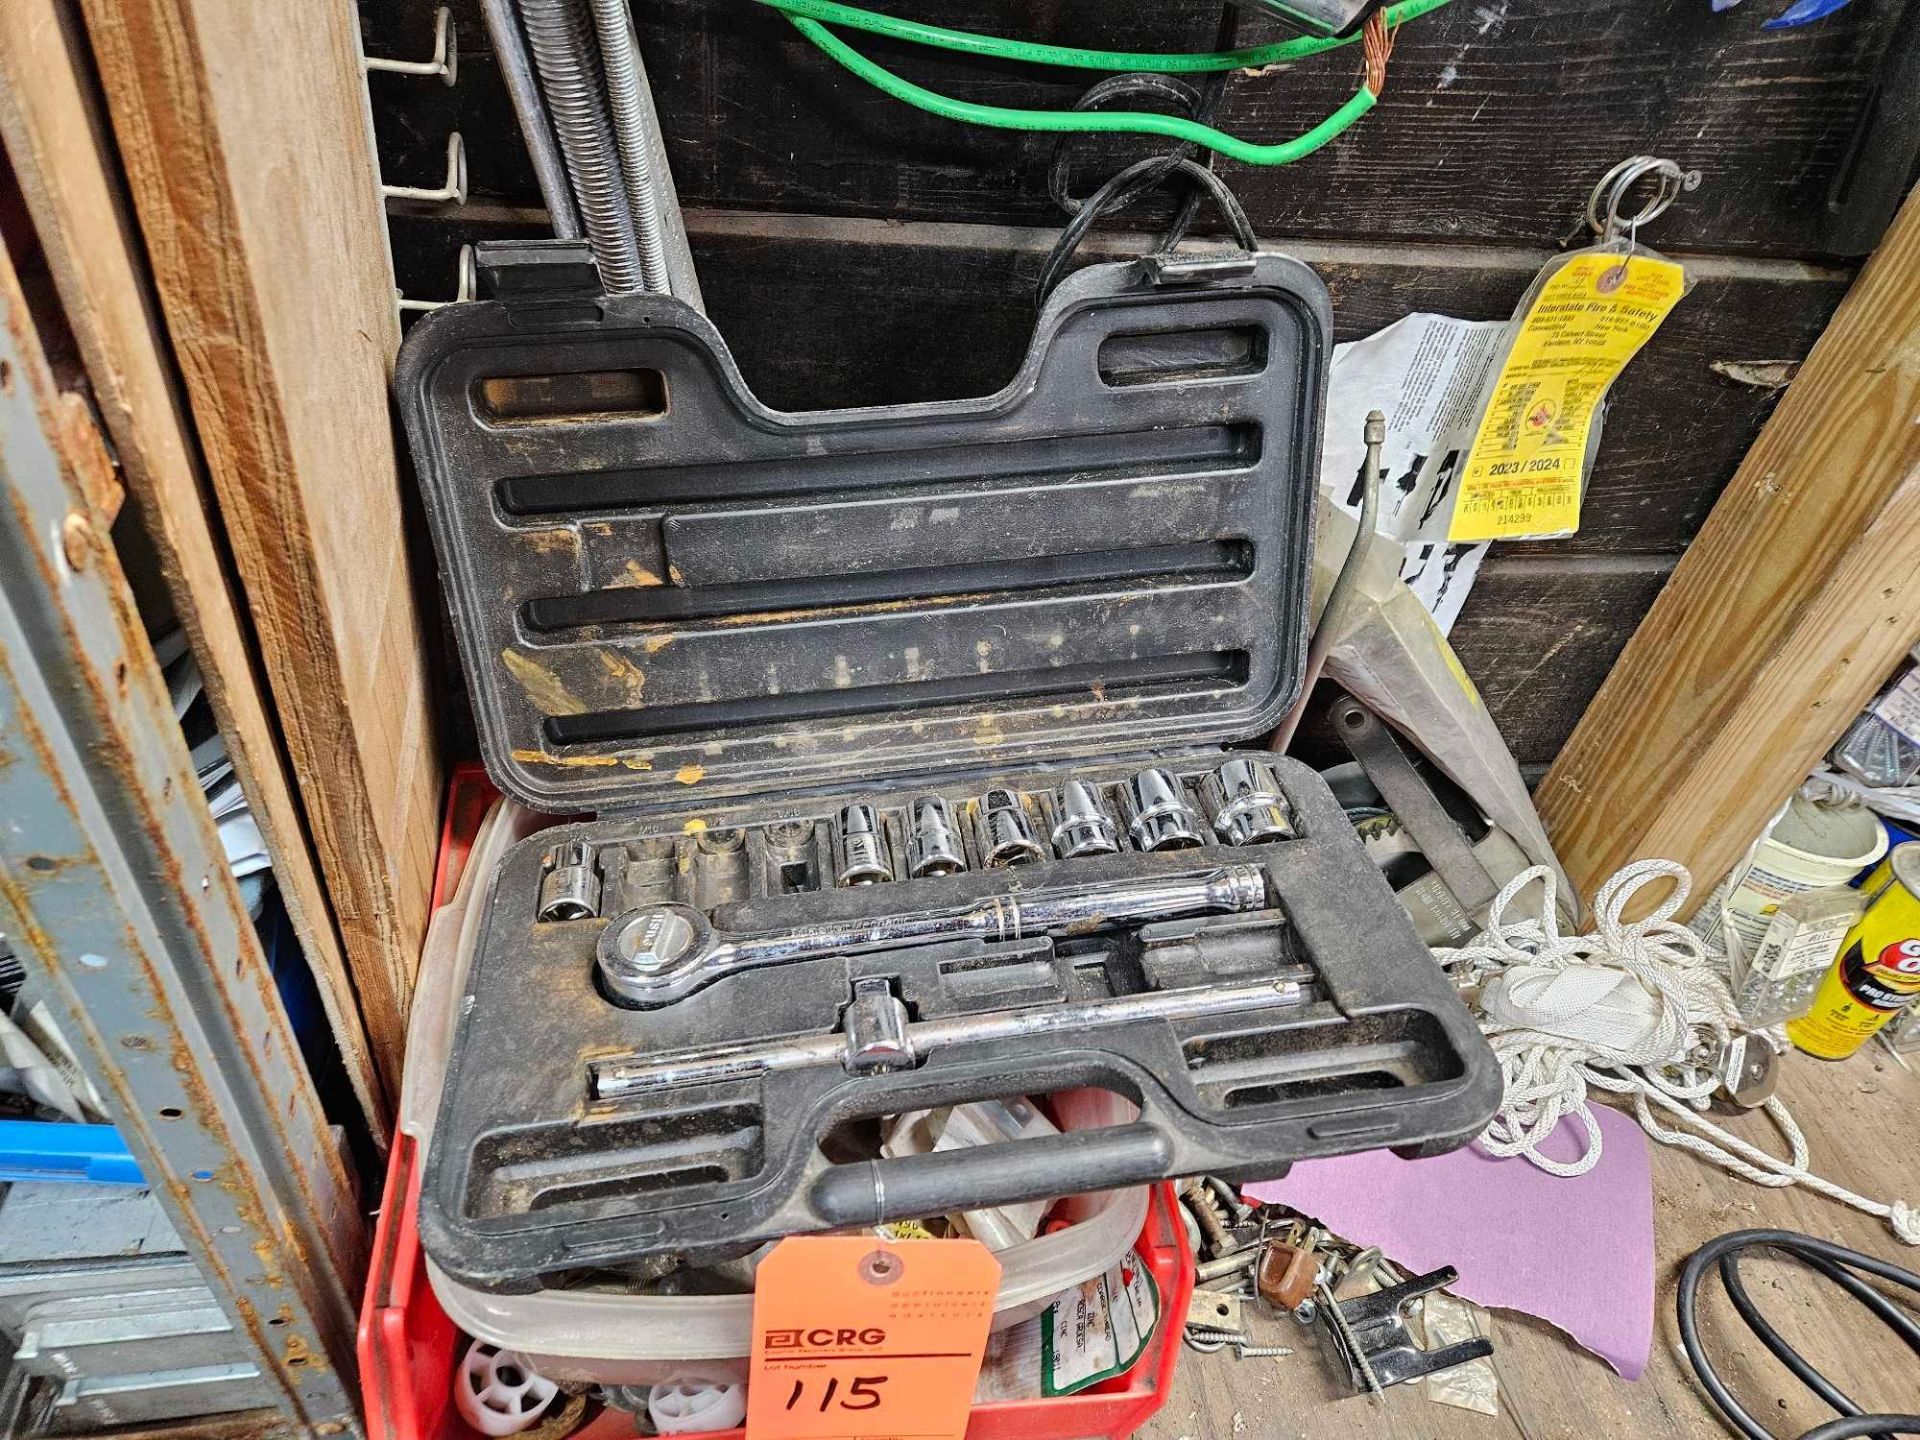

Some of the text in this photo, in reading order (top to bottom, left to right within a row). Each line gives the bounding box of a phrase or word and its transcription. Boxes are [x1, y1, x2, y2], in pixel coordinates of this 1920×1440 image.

[1537, 302, 1585, 313] Interstate
[1586, 302, 1607, 312] Fire
[1620, 304, 1657, 322] Safety
[1489, 461, 1520, 476] 2023
[1529, 458, 1561, 472] 2024
[1859, 984, 1885, 999] PRO
[807, 1328, 886, 1346] CRG
[786, 1376, 888, 1412] 115
